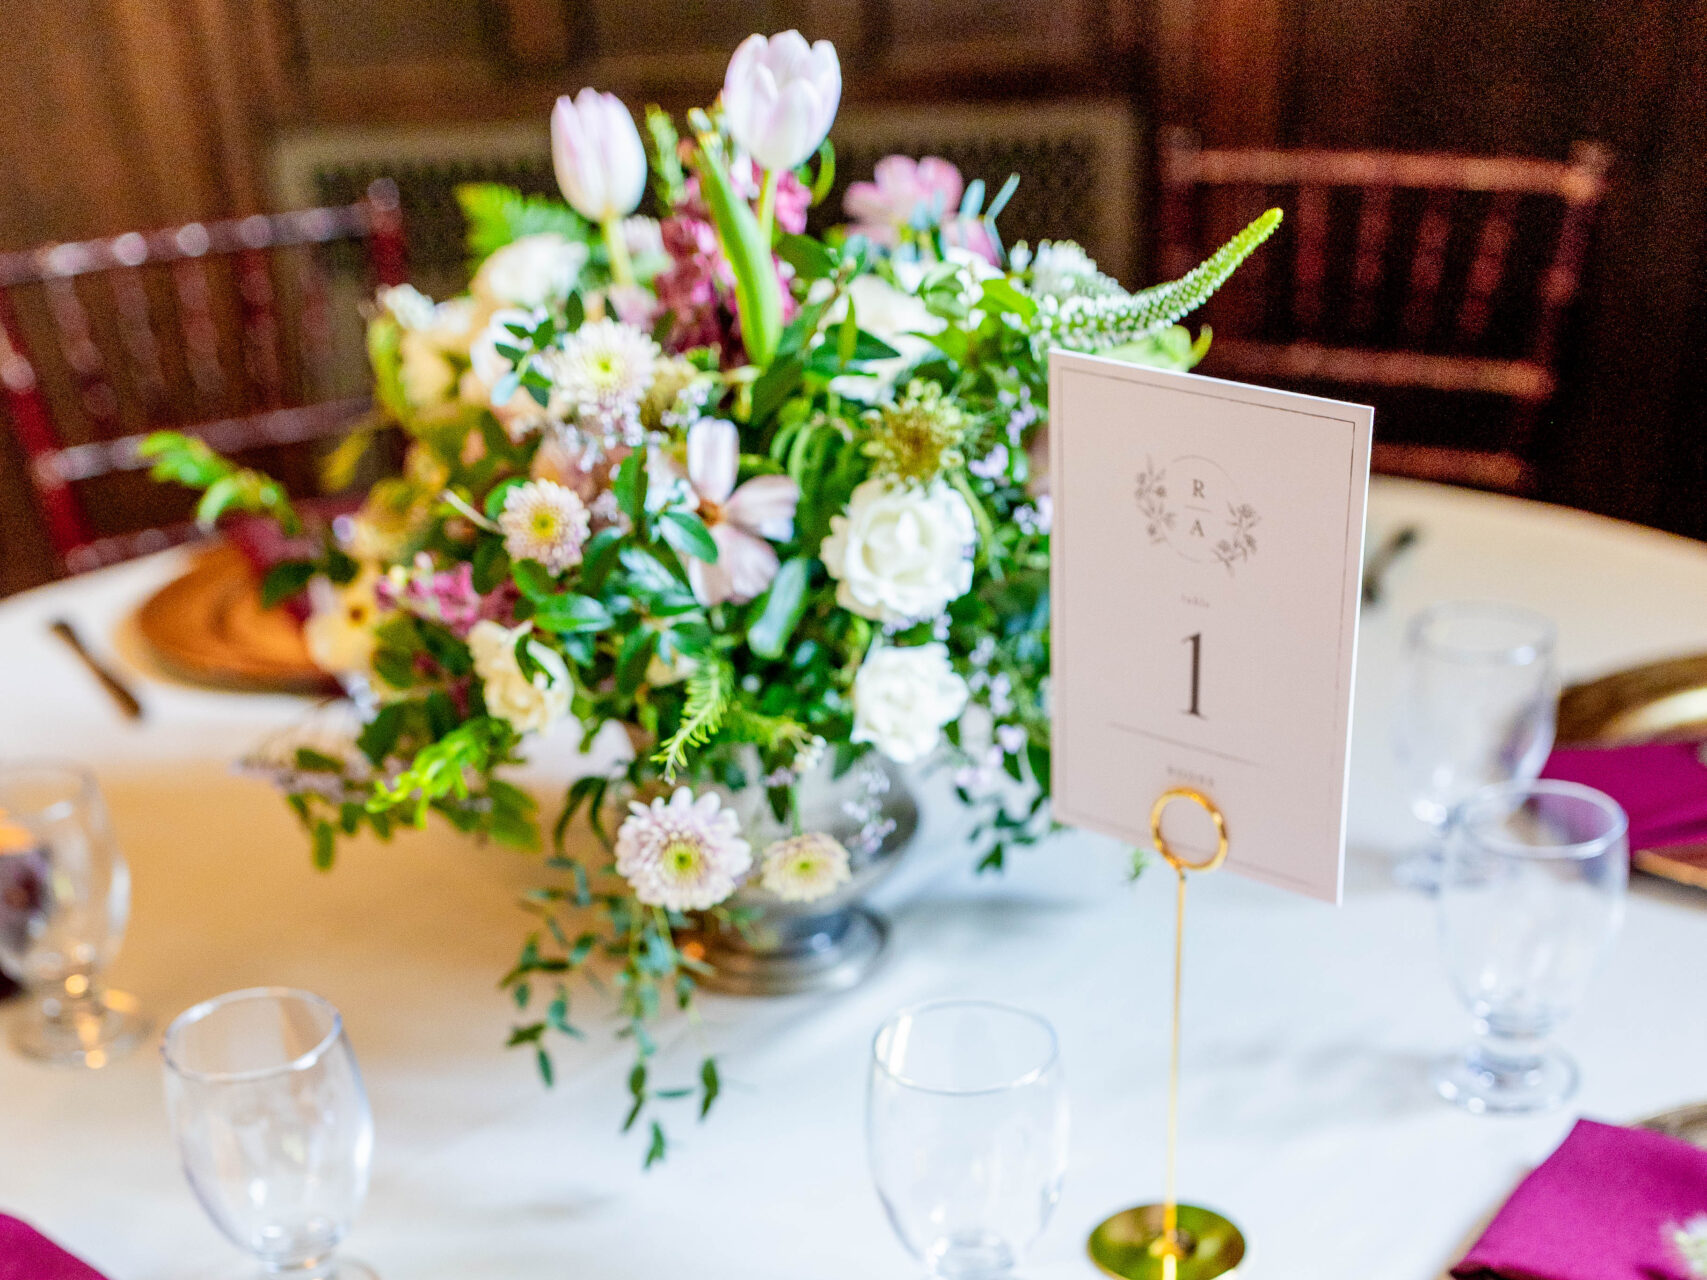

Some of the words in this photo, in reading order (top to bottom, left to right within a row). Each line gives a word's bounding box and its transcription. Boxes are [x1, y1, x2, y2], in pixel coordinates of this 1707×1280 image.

[1192, 479, 1205, 499] R
[1190, 519, 1205, 538] A
[1179, 632, 1208, 720] 1
